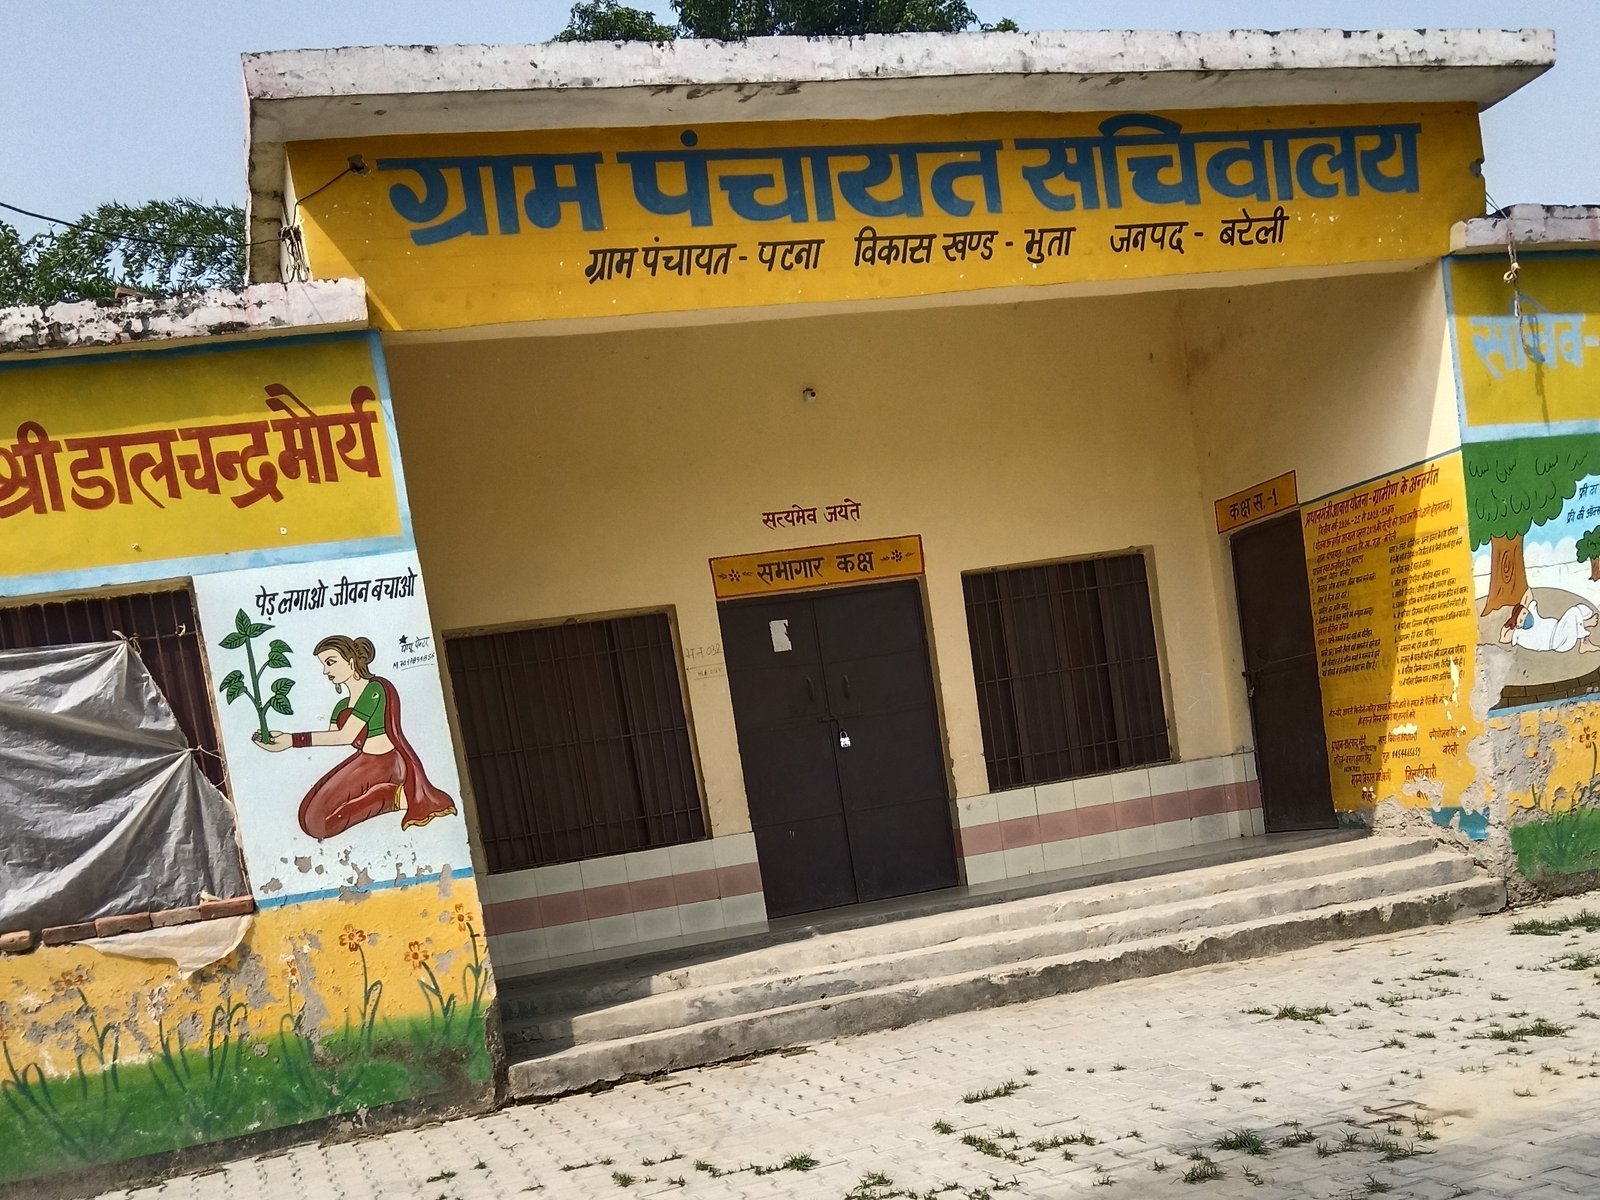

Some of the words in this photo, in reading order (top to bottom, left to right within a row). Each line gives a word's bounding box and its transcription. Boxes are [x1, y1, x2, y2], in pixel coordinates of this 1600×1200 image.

[376, 151, 604, 246] ग्राम
[617, 129, 1003, 228] पंचायत
[1014, 112, 1422, 212] सचिवालय
[584, 247, 638, 284] ग्राम
[641, 236, 737, 279] पंचायत
[757, 239, 826, 272] पटना
[854, 226, 936, 268] विकास
[941, 229, 999, 261] खण्ड
[1024, 226, 1077, 264] भुता
[1109, 221, 1189, 254] जनपद
[1219, 206, 1290, 246] बरेली
[1401, 476, 1409, 495] के
[1409, 463, 1440, 494] अन्तर्गत
[761, 504, 818, 530] सत्यमेव
[823, 497, 862, 523] जयते
[1229, 498, 1251, 520] कक्ष
[757, 556, 825, 586] सभागार
[836, 550, 875, 574] कक्ष
[255, 585, 280, 621] पेड़
[277, 579, 329, 615] लगाओ
[330, 576, 369, 608] जीवन
[371, 566, 418, 602] बचाओ
